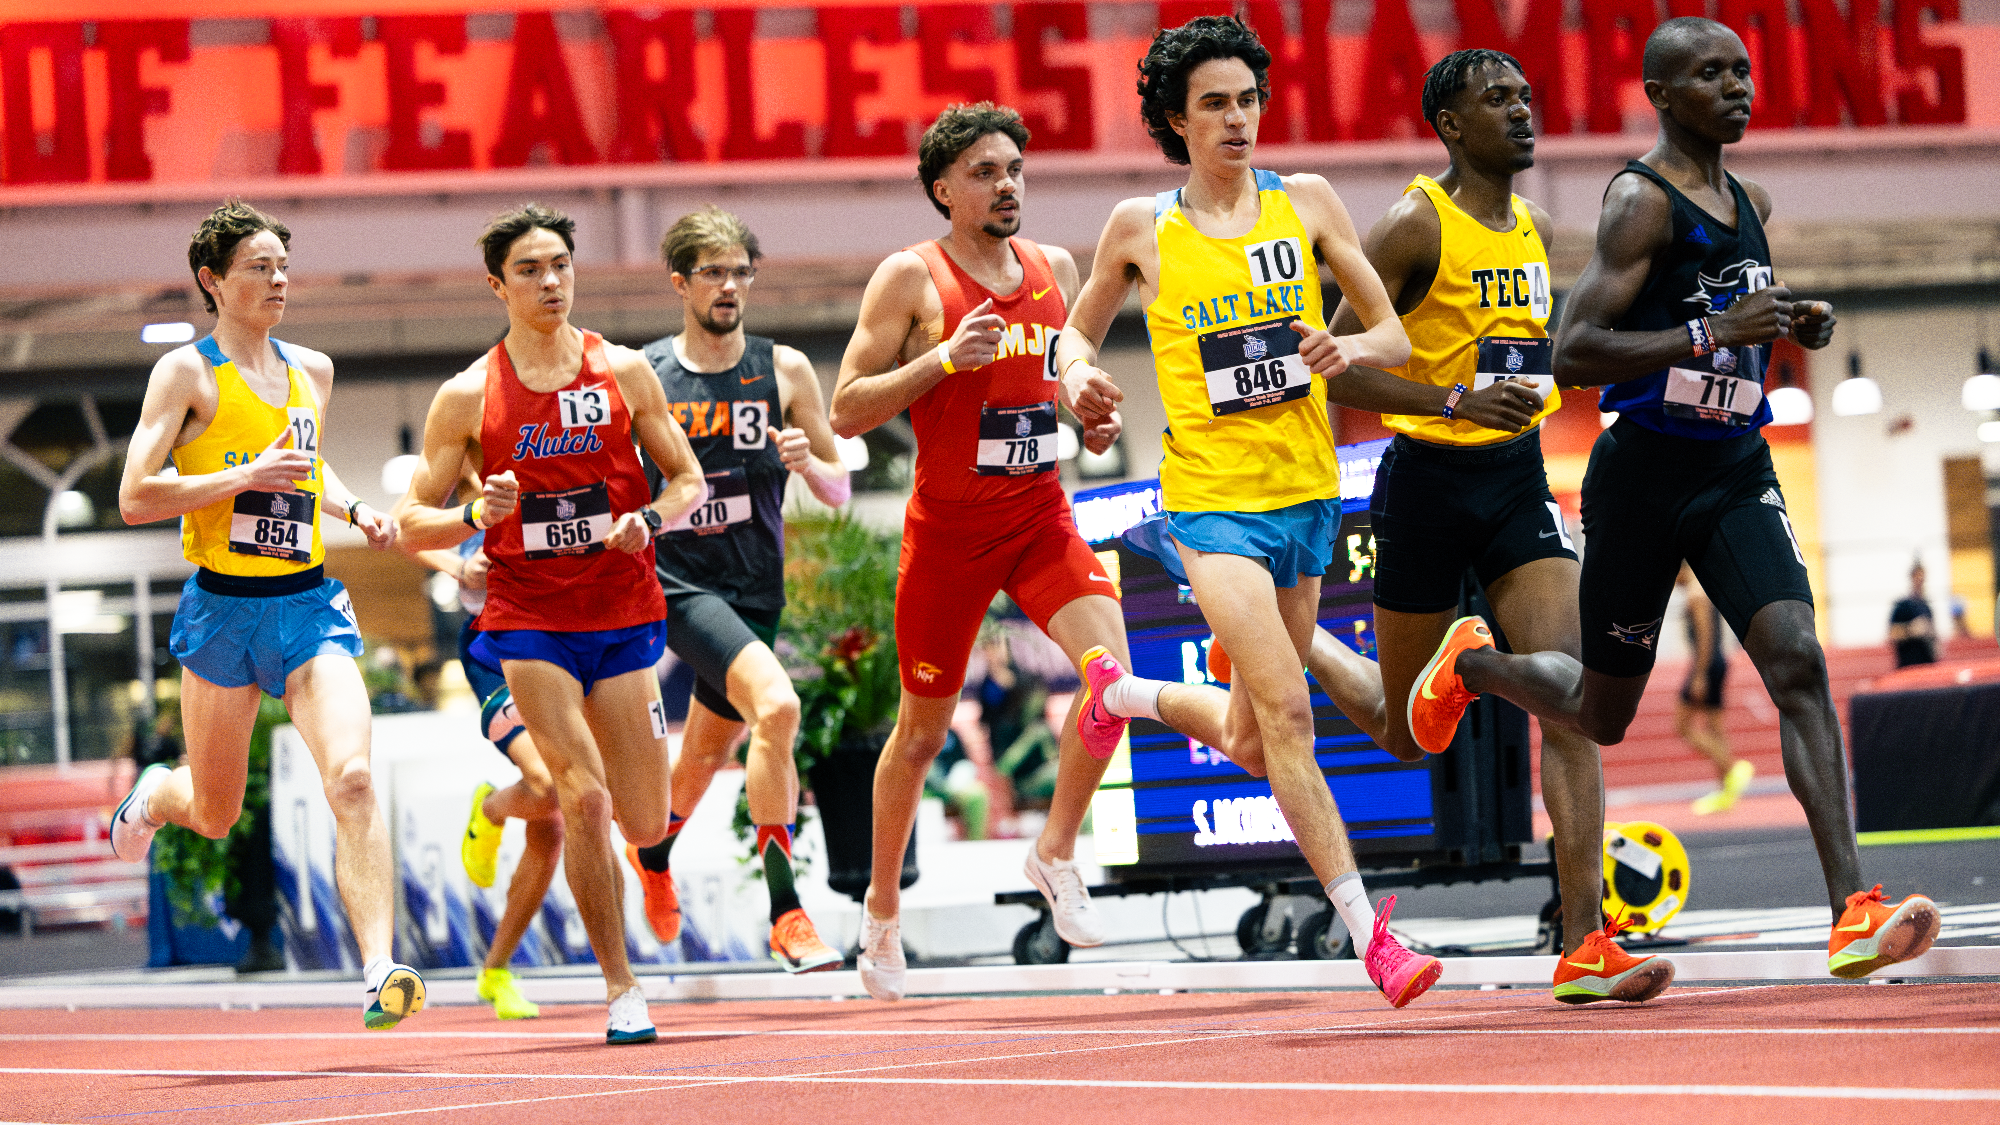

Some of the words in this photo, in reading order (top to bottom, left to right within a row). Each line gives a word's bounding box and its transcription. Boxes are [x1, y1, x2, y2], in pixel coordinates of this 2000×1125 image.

[2, 17, 191, 186] OF
[270, 2, 1094, 175] FEARLESS
[1157, 0, 1968, 144] HAMPONS
[1251, 240, 1297, 283] 10
[1182, 293, 1239, 330] SALT
[1246, 284, 1305, 318] LAKE
[1533, 266, 1548, 315] 4
[1233, 359, 1287, 396] 846
[1700, 374, 1739, 409] 711
[563, 392, 604, 425] 13
[739, 406, 762, 445] 3
[292, 417, 316, 452] 12
[512, 422, 603, 462] Hutch
[1005, 438, 1039, 465] 778
[254, 518, 298, 548] 854
[545, 519, 592, 548] 656
